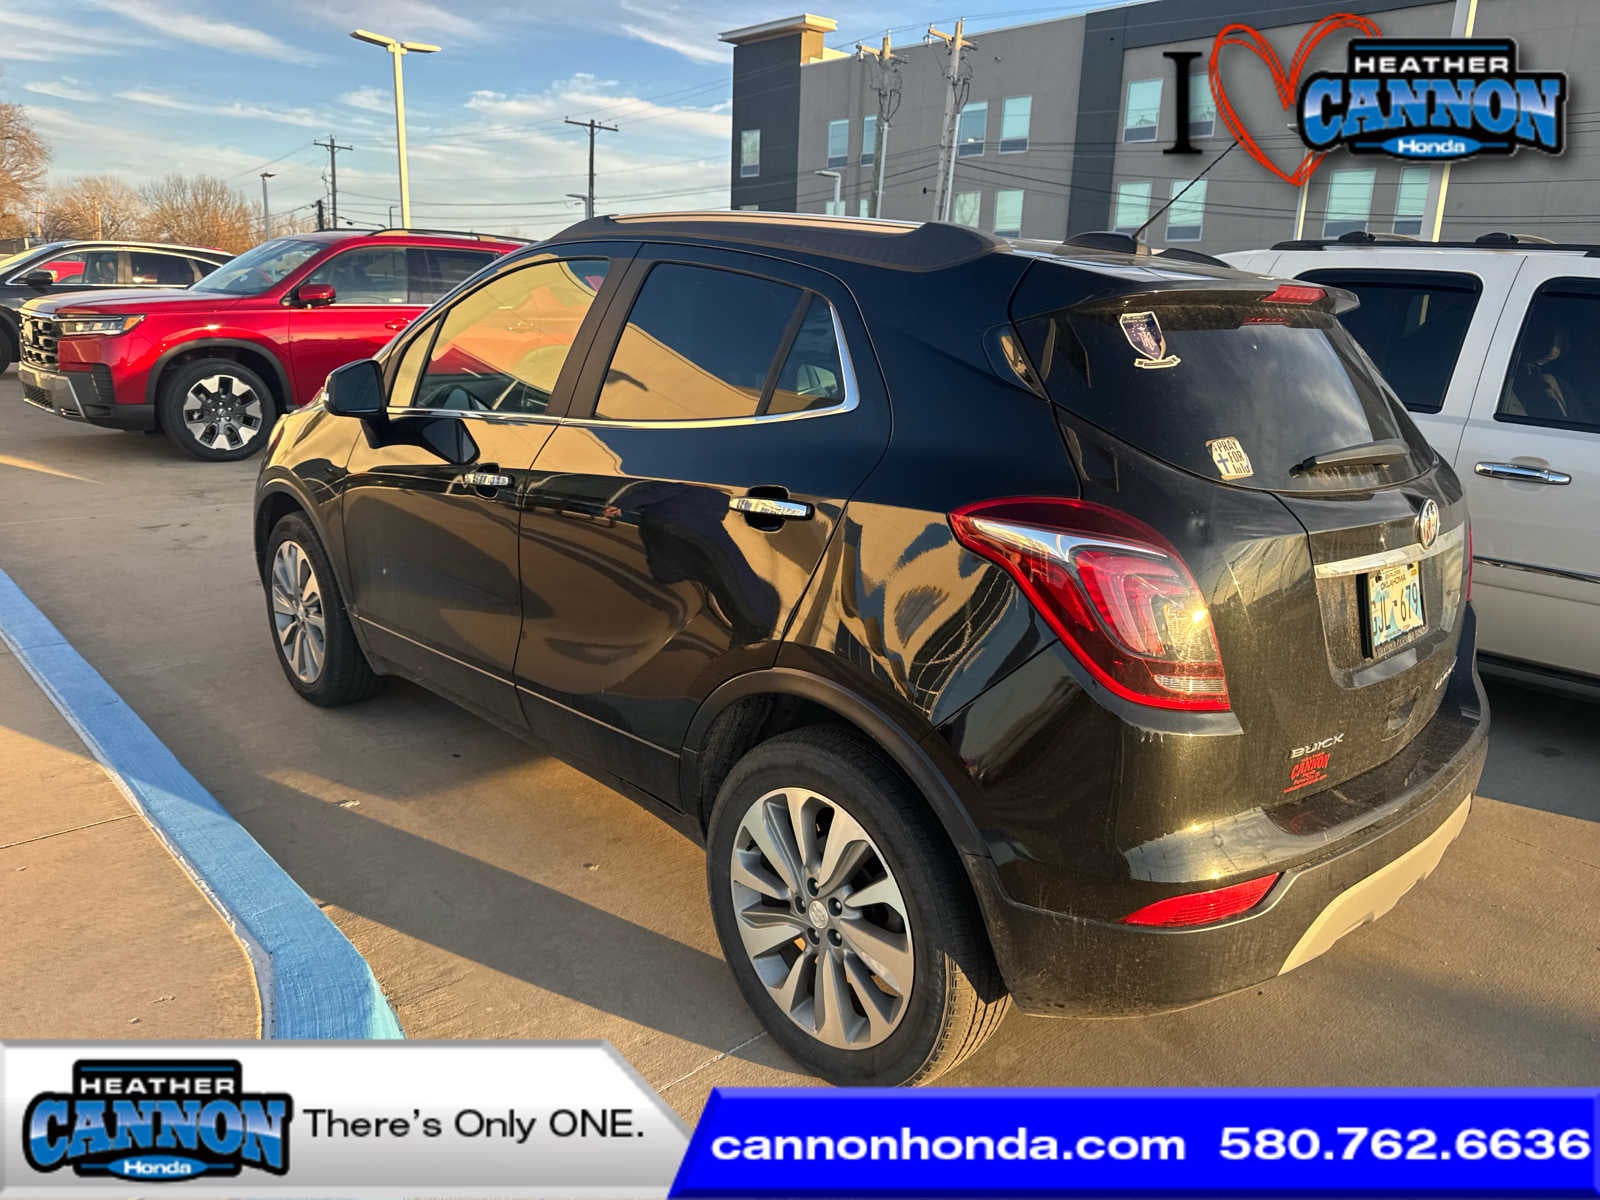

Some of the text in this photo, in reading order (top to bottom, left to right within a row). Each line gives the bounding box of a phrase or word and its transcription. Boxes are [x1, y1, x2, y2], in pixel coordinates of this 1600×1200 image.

[1216, 440, 1238, 453] PRAY
[1228, 450, 1244, 463] FOR
[1401, 582, 1418, 622] 679
[1290, 732, 1345, 759] BUICK
